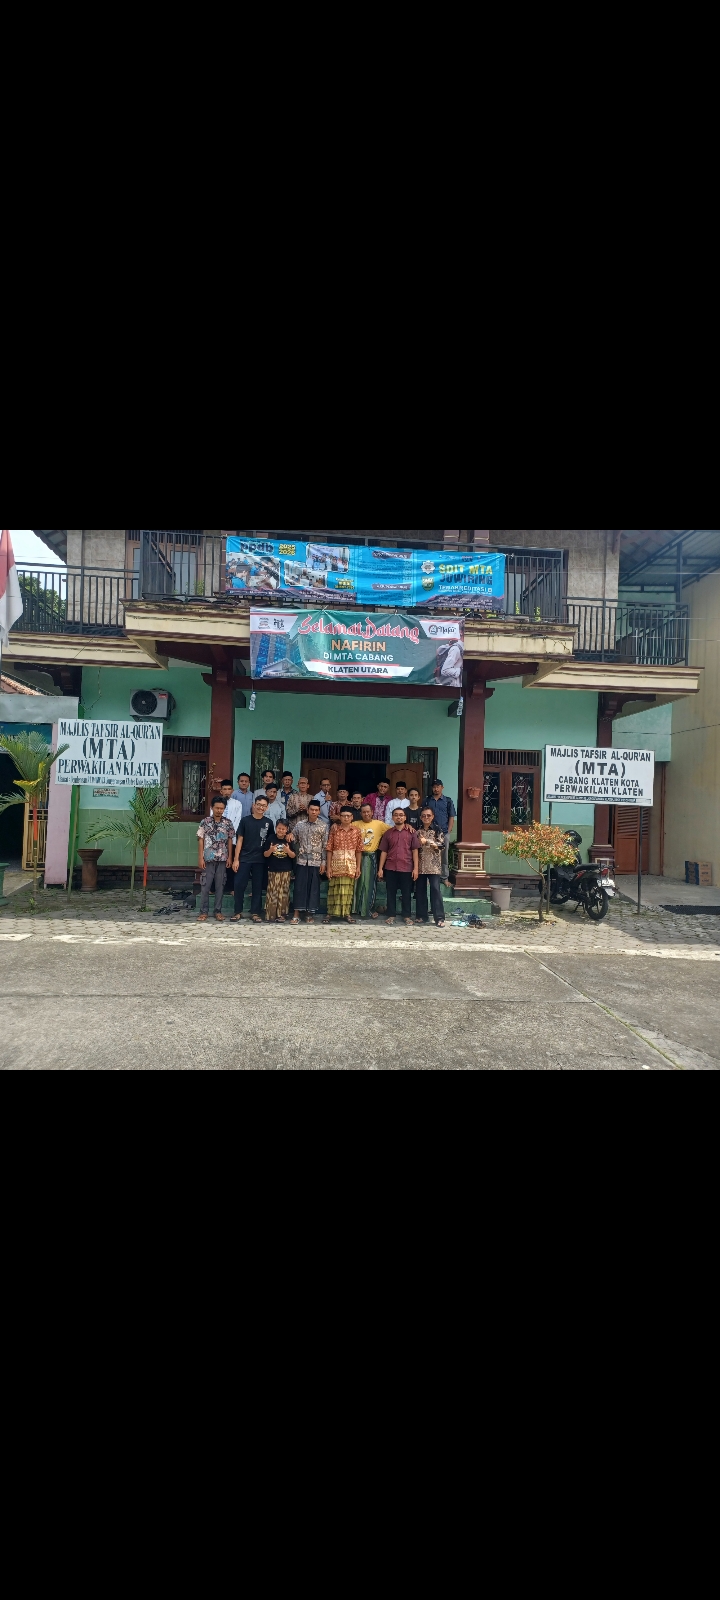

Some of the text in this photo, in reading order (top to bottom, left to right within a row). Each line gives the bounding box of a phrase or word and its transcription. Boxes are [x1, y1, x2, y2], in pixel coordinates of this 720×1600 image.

[240, 541, 274, 554] ppdb
[438, 564, 465, 574] SDIT
[470, 564, 493, 574] MTA
[298, 614, 364, 634] Selamat
[362, 617, 420, 644] Datang
[331, 639, 386, 652] NAFIRIN
[333, 652, 353, 660] MTA
[355, 653, 394, 662] CABANG
[328, 665, 389, 674] KLATEN UTARA
[60, 722, 160, 740] MAJLIS TAFSIR AL-QUR'AN
[82, 737, 136, 761] (MTA)
[550, 748, 650, 762] MAJLIS TAFSIR AL-QUR'AN
[58, 758, 159, 776] PERWAKILAN KLATEN
[575, 760, 626, 778] (MTA)
[558, 776, 639, 788] CABANG KLATEN KOTA
[554, 784, 644, 796] PERWAKILAN KLATEN
